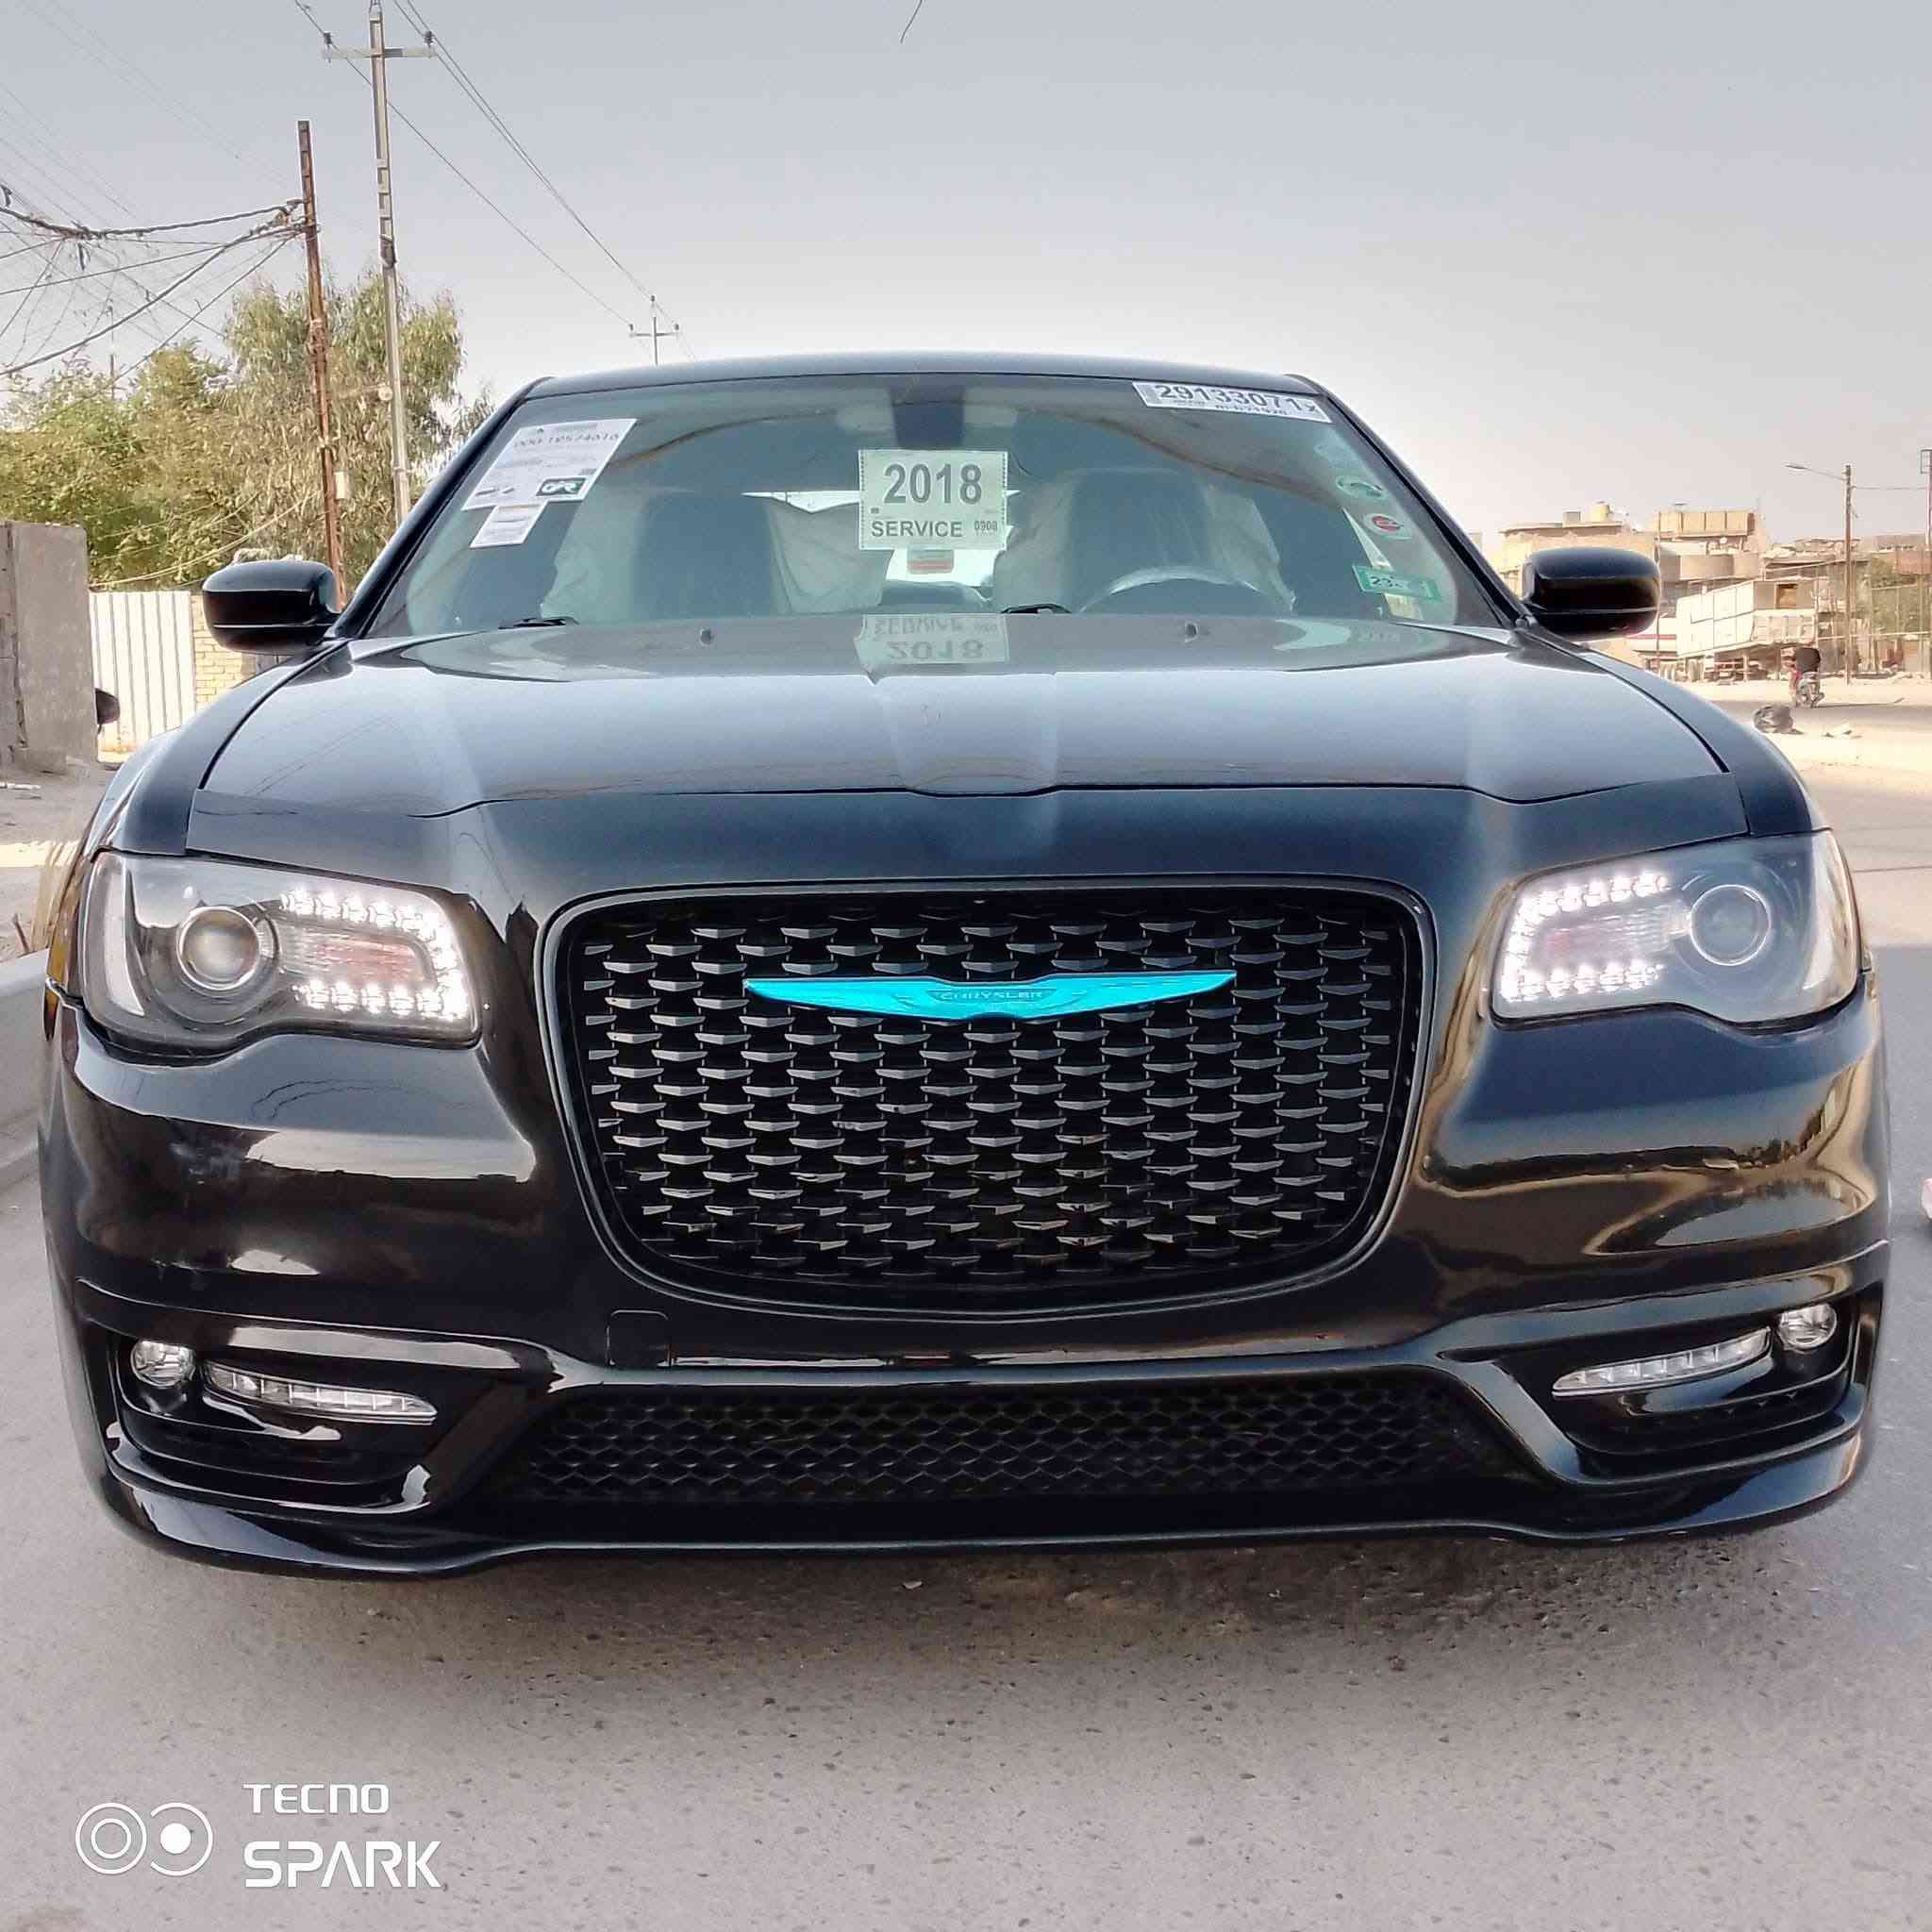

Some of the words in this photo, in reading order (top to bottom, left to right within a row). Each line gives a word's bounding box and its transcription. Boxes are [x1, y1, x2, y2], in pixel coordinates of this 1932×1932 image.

[883, 463, 982, 504] 2018
[871, 520, 962, 537] SERVICE
[941, 991, 1042, 1001] CHRYSLER
